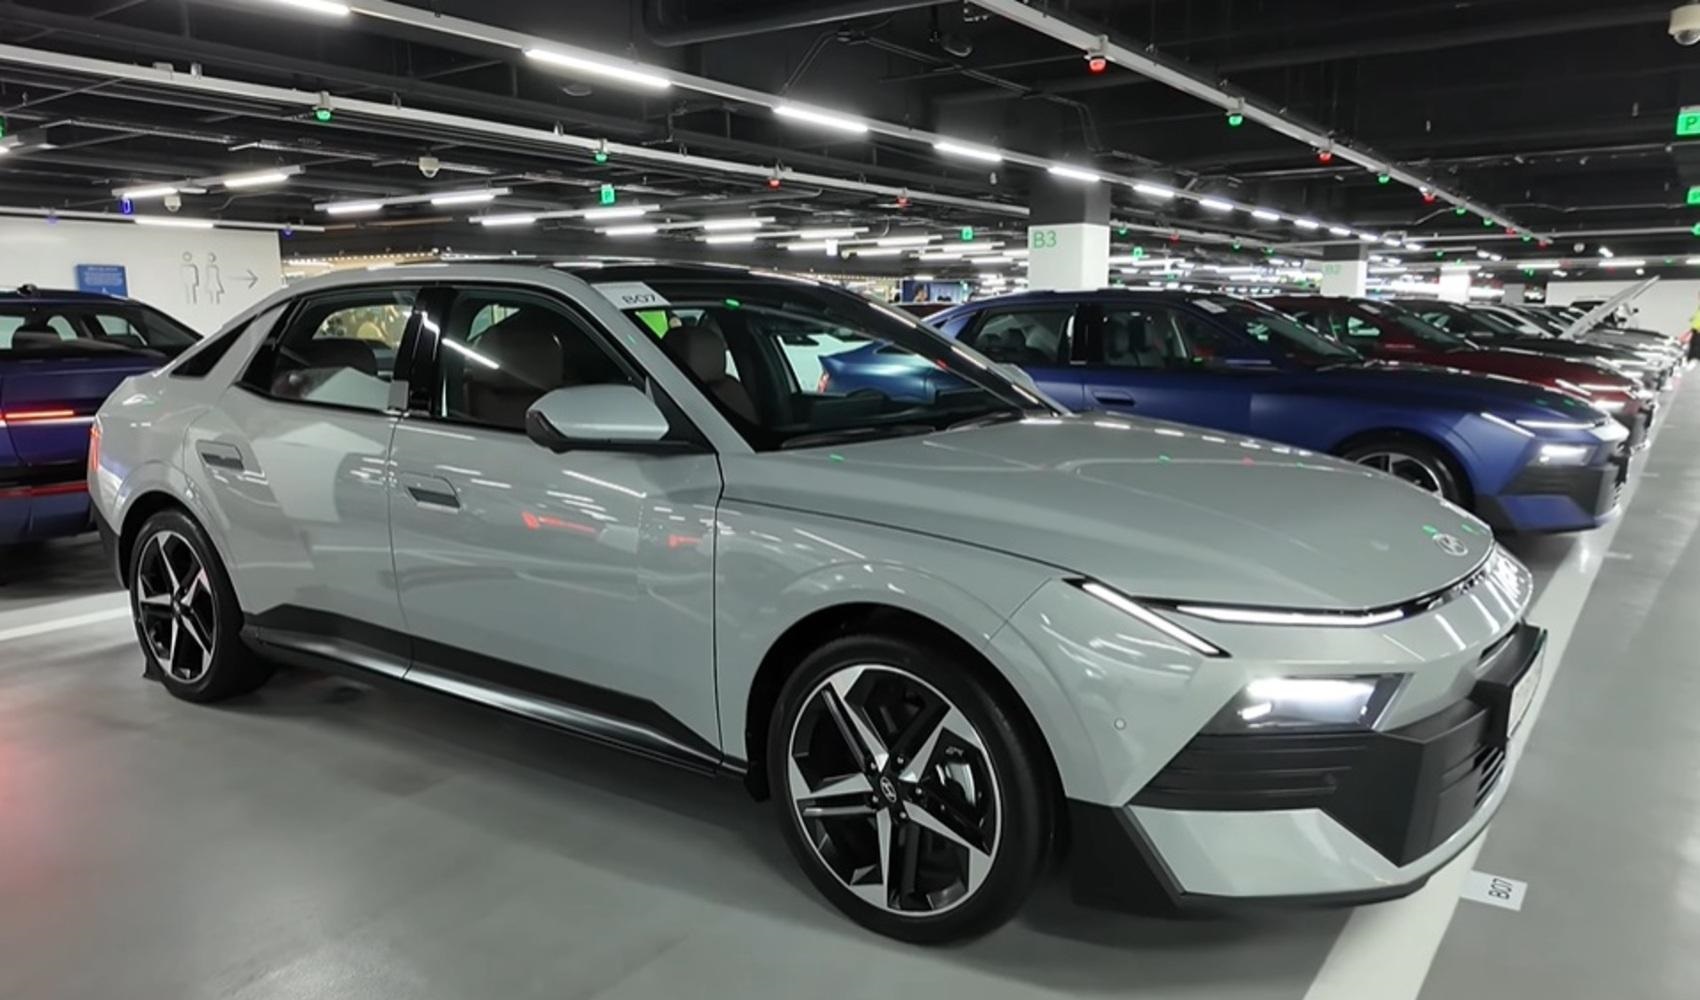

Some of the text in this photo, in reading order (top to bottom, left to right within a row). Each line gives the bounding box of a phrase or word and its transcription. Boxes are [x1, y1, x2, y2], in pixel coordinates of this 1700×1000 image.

[1685, 116, 1697, 131] P
[1033, 230, 1057, 249] B3
[621, 293, 656, 305] B07
[1488, 877, 1513, 900] B07
